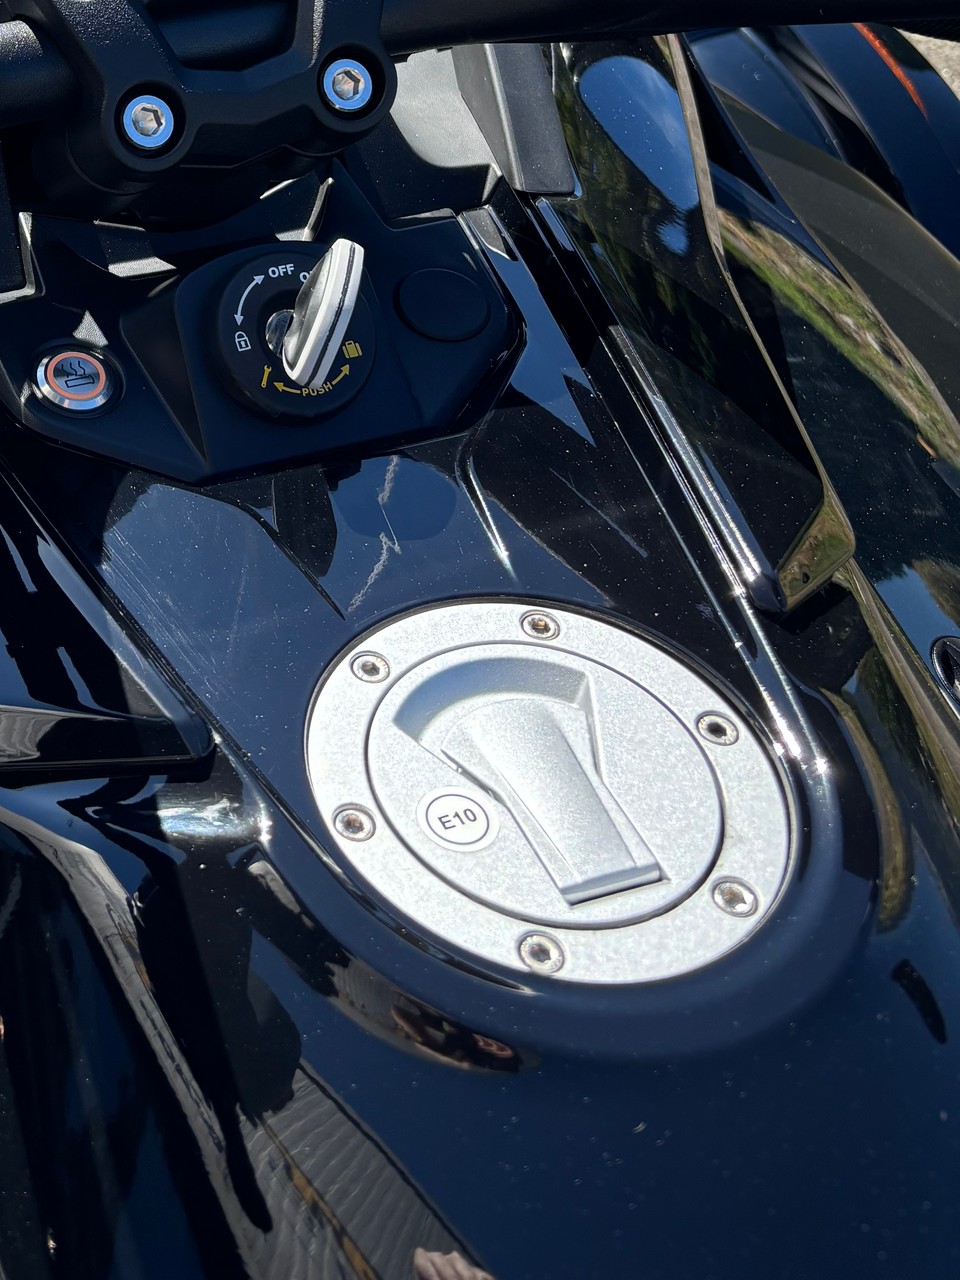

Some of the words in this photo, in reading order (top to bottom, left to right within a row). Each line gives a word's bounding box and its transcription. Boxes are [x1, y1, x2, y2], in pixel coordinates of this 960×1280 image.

[268, 263, 295, 278] OFF
[299, 270, 313, 283] O
[302, 381, 333, 397] PUSH
[437, 808, 477, 830] E10
